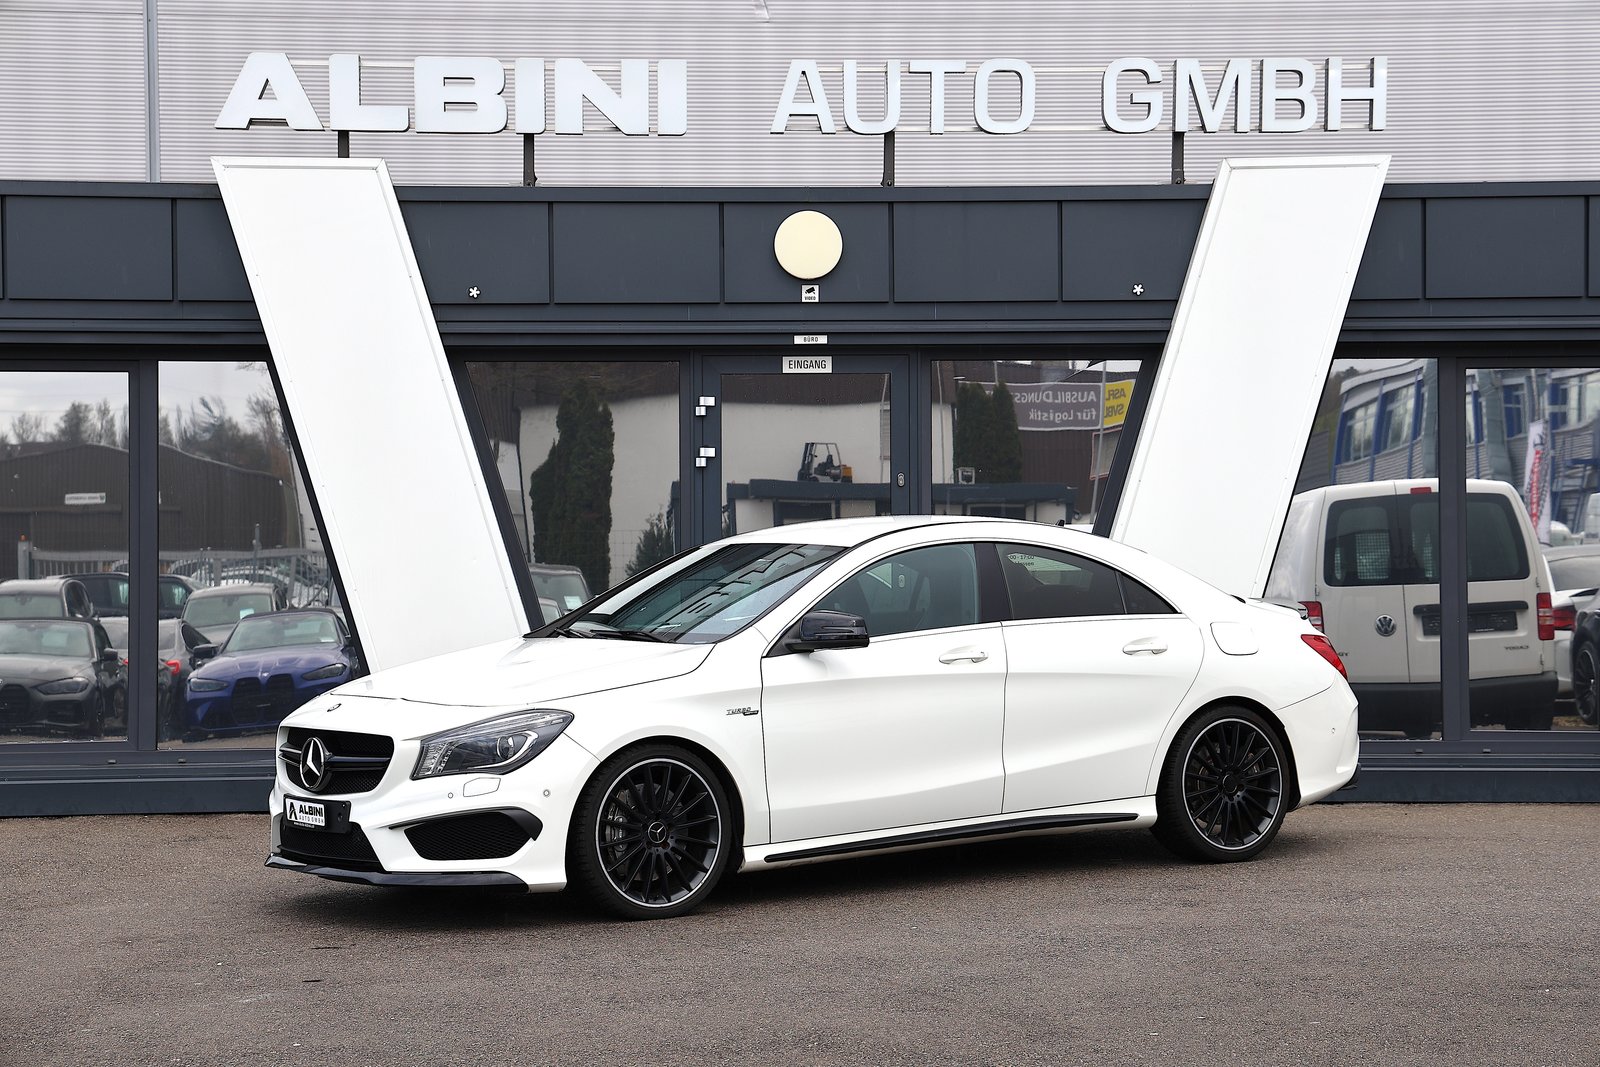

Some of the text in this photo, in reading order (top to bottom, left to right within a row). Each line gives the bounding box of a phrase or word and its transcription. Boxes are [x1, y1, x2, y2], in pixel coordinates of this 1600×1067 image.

[214, 52, 1388, 135] ALBINI AUTO GMBH
[788, 360, 827, 369] EINGANG
[299, 804, 324, 817] ALBINI
